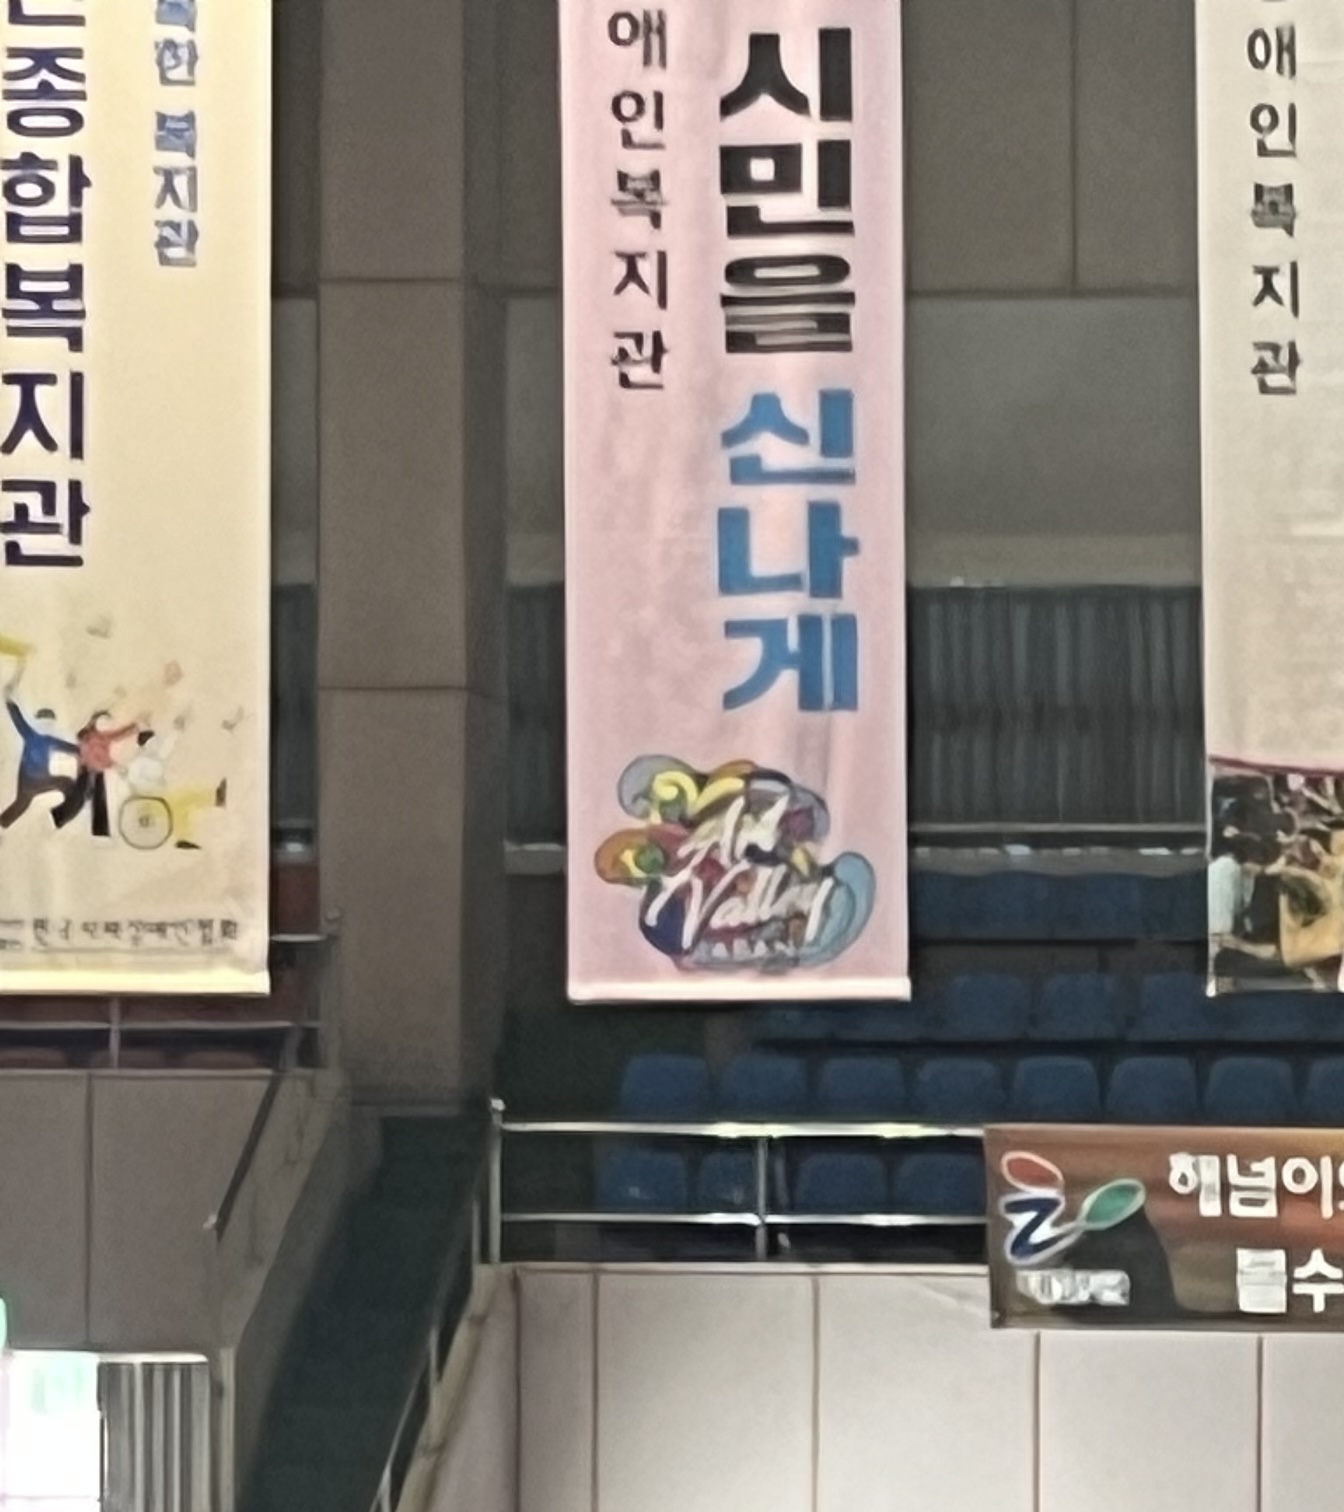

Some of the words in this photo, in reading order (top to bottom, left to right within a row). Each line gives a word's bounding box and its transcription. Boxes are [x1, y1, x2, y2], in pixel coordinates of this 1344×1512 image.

[153, 109, 198, 267] 복지관
[606, 10, 668, 391] 애인복지관
[719, 27, 855, 354] 시민을
[1247, 22, 1301, 396] 애인복지관
[717, 388, 859, 712] 신나게
